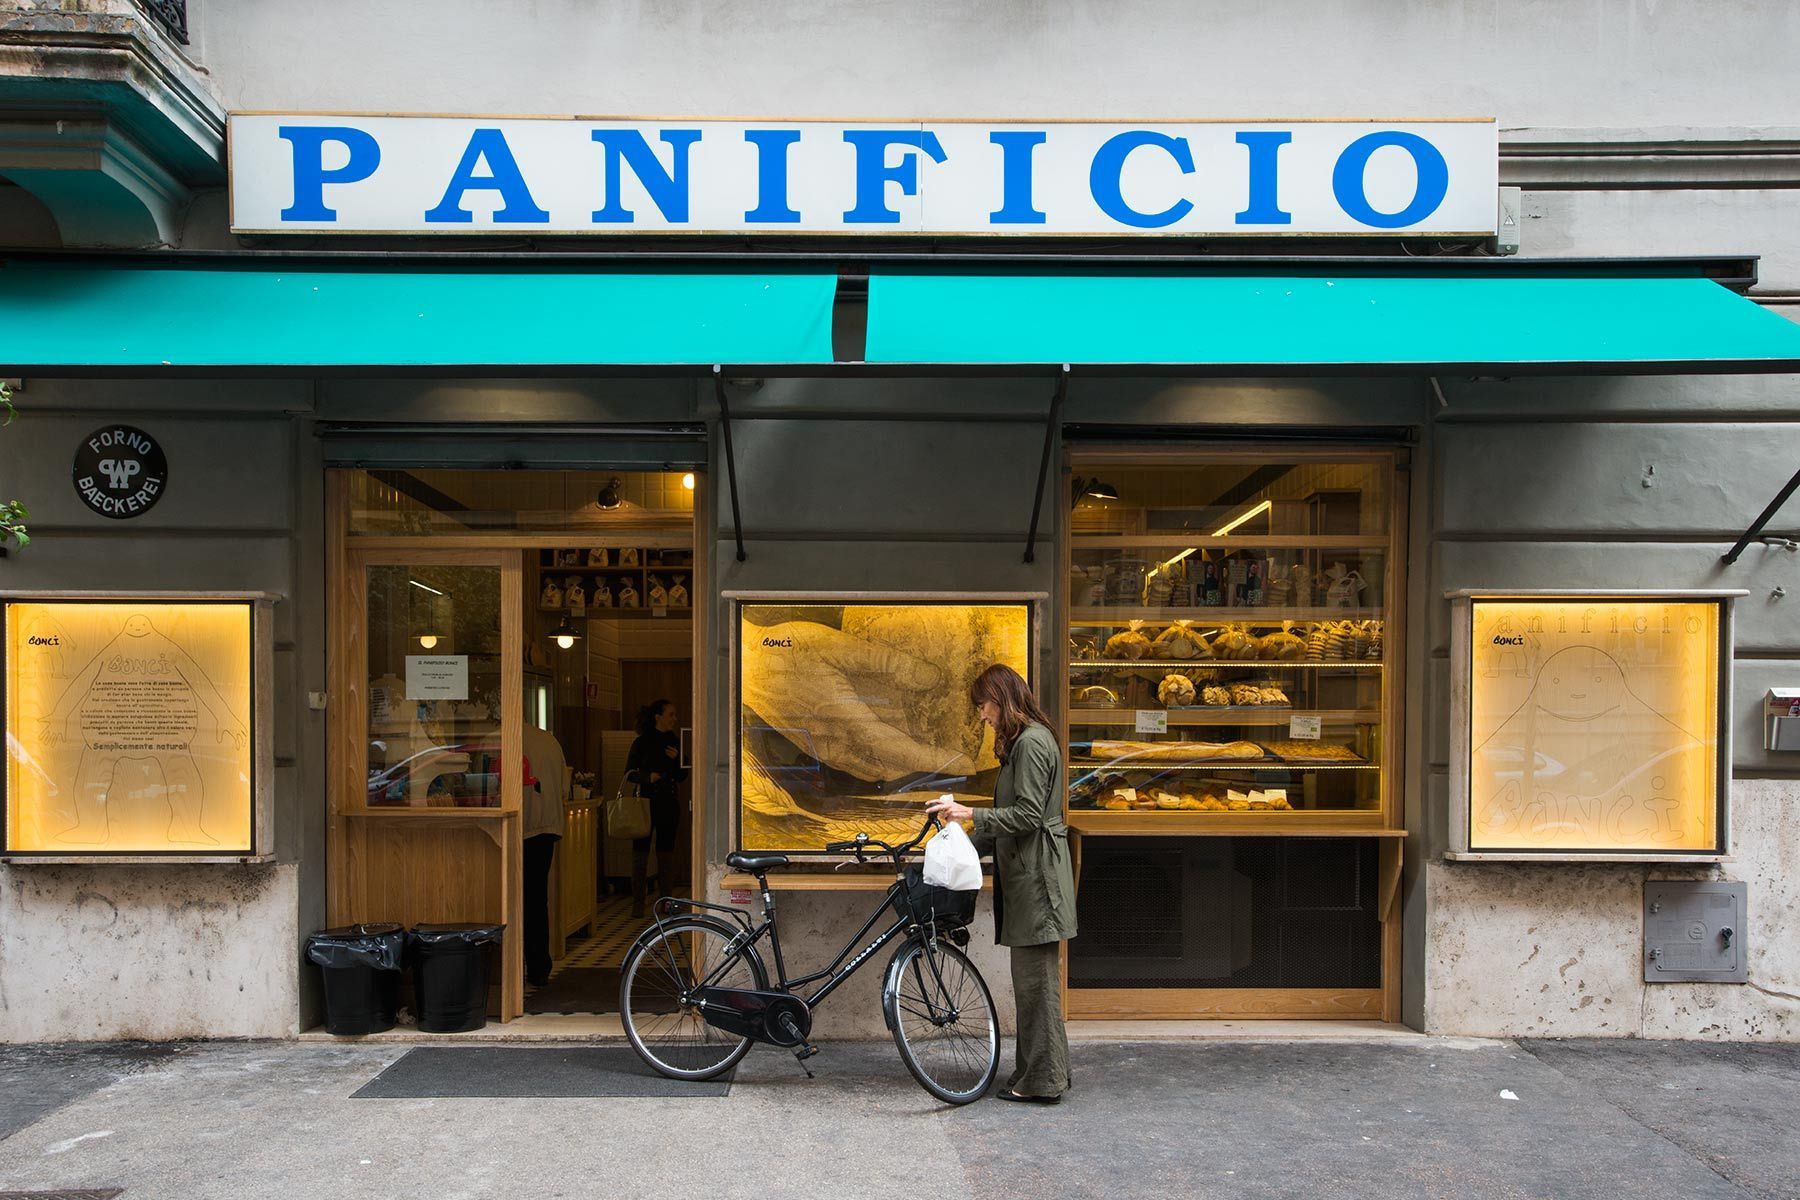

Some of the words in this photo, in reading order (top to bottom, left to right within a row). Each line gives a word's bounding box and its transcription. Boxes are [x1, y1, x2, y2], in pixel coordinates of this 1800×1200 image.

[279, 126, 1448, 228] PANIFICIO
[89, 430, 152, 455] FORNO
[78, 476, 161, 514] BAECKEREI
[93, 742, 154, 752] Semplicemente
[156, 742, 188, 751] naturali
